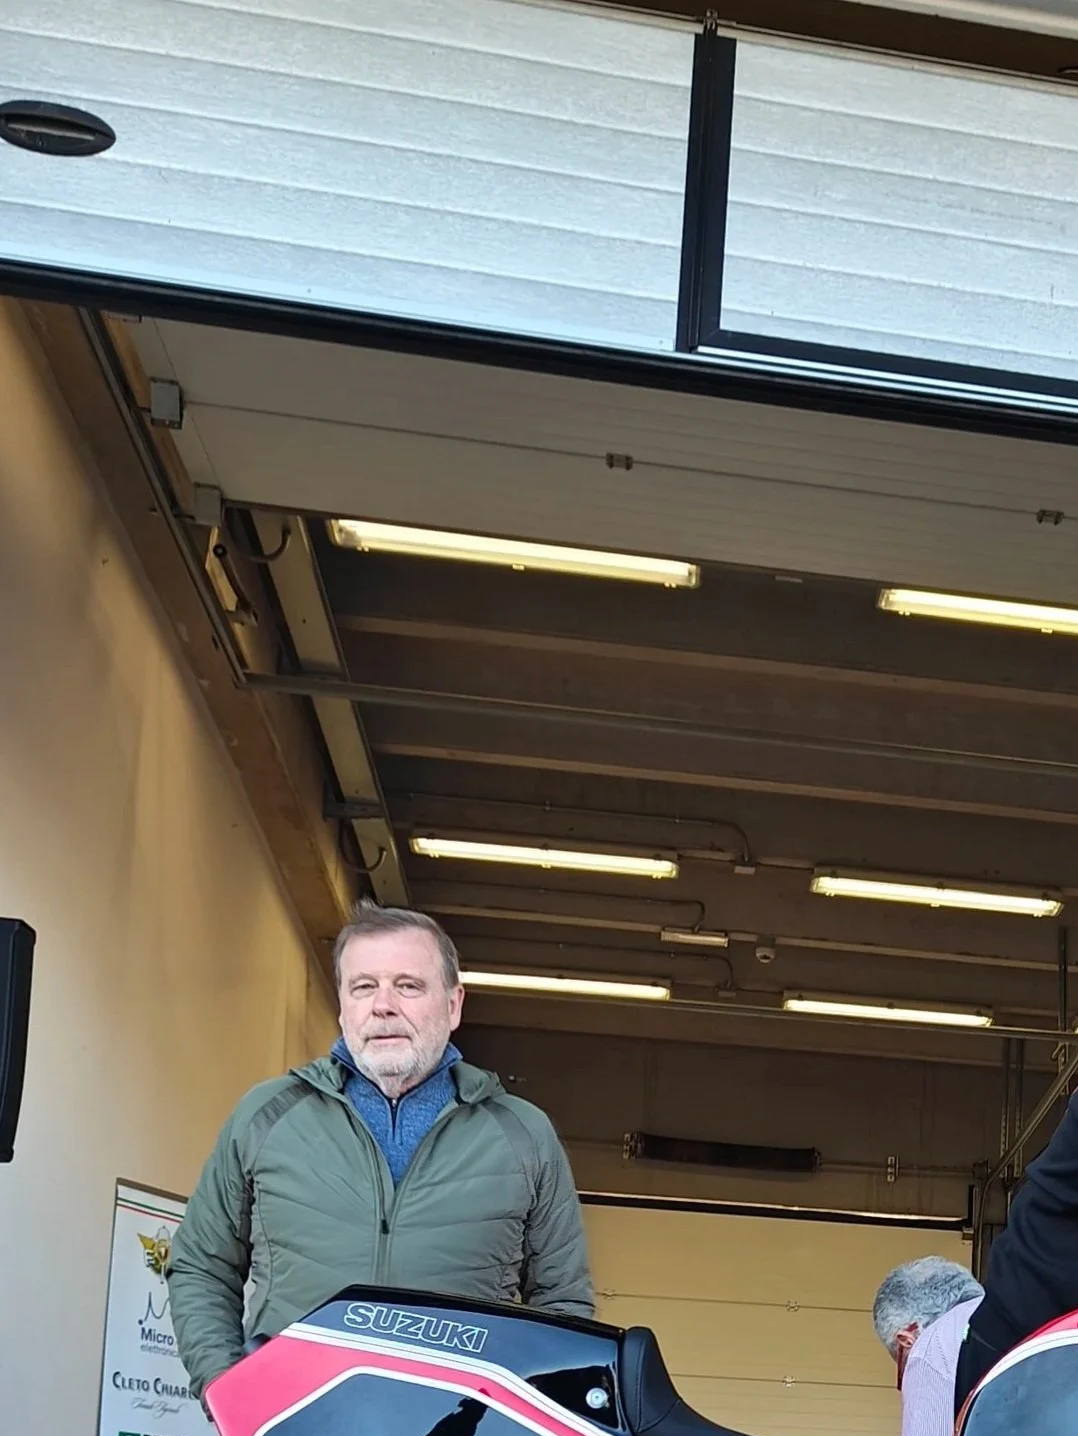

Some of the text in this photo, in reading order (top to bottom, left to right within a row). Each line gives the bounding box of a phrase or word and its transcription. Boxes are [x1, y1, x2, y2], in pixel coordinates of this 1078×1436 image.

[140, 1327, 175, 1347] Micro
[343, 1302, 489, 1354] SUZUKI
[112, 1371, 150, 1393] CLETO
